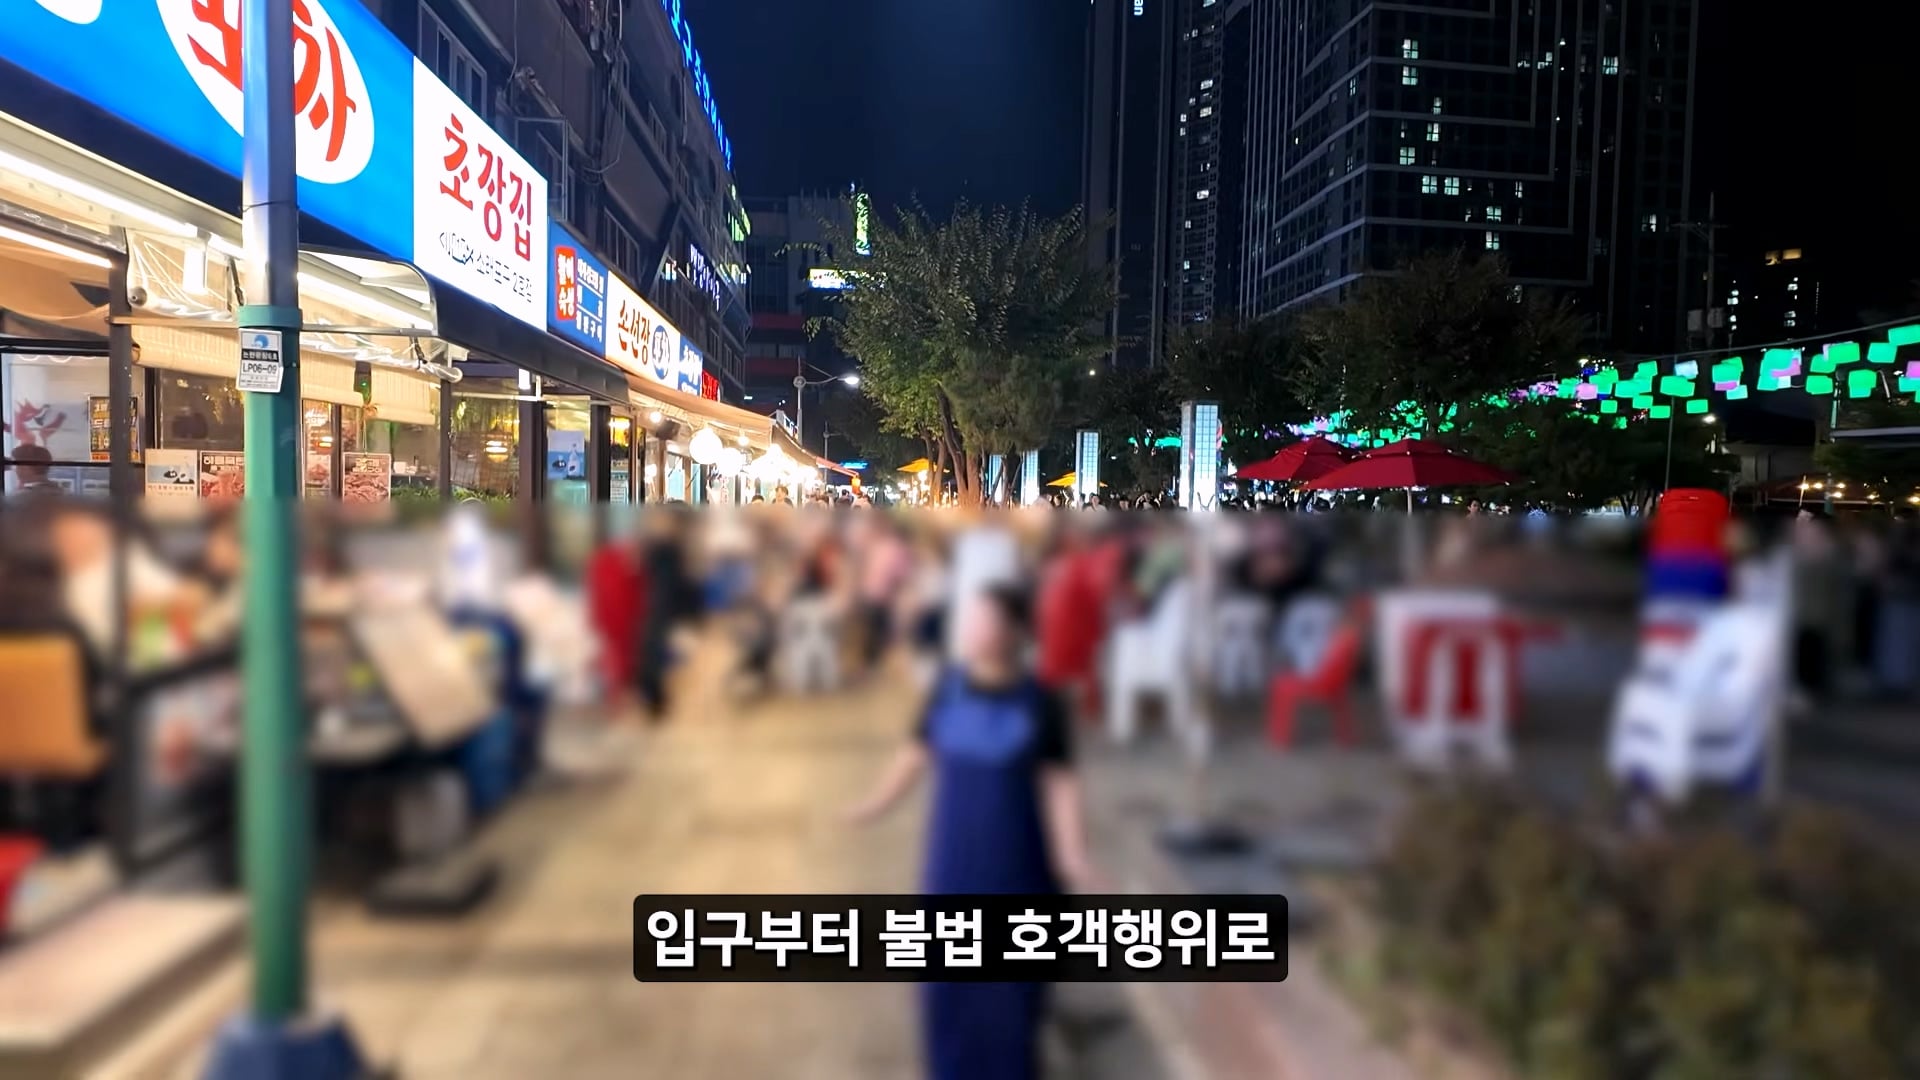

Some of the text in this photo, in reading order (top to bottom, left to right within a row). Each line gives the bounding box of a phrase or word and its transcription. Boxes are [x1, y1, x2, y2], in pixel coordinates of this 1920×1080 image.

[439, 112, 532, 262] 초장집
[617, 299, 651, 366] 손선장
[242, 362, 278, 375] LP06-09
